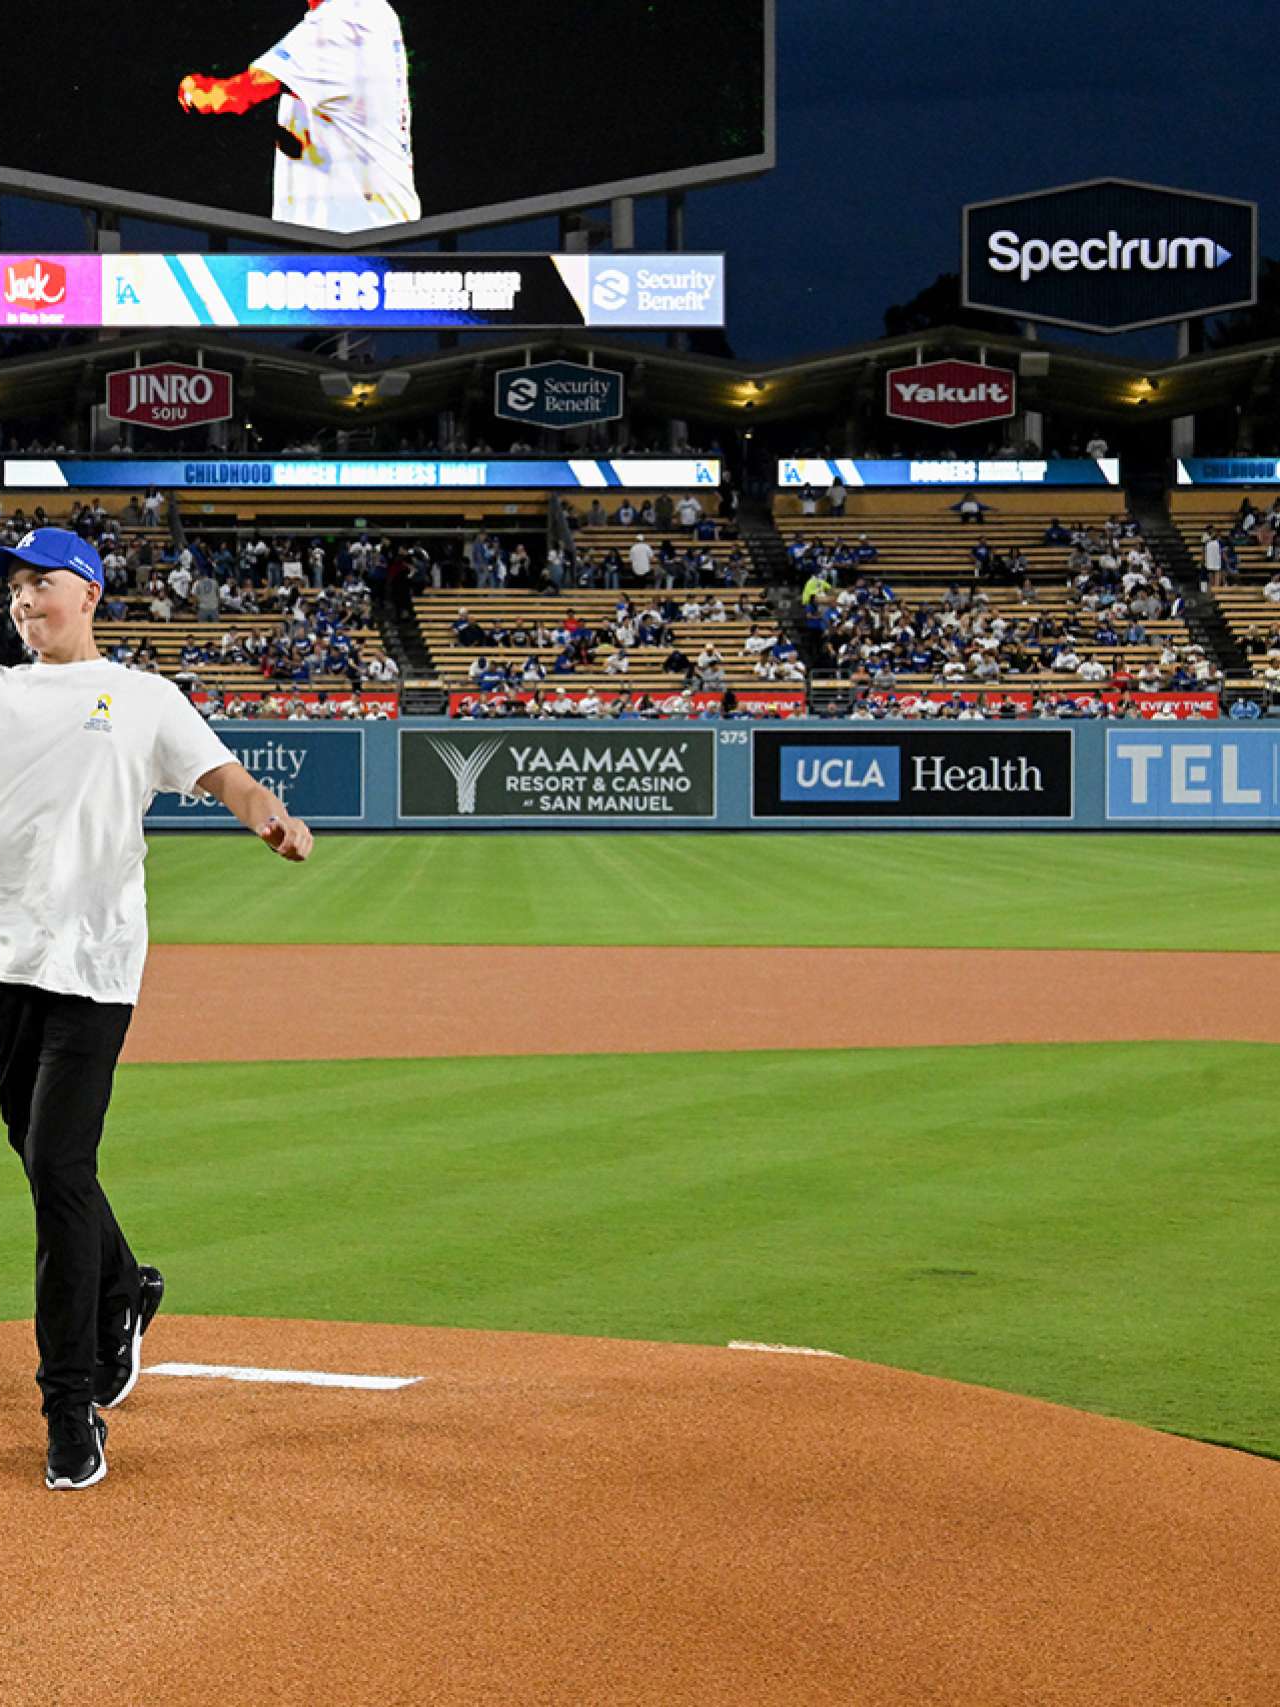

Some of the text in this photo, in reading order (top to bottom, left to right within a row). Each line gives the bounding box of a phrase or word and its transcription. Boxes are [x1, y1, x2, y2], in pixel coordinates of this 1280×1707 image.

[987, 230, 1215, 282] Spectrum
[4, 263, 65, 302] Jack
[115, 275, 141, 305] LA
[636, 269, 716, 292] Security
[637, 291, 705, 312] Benefit
[126, 374, 213, 413] JINRO
[544, 378, 610, 397] Security
[894, 383, 1009, 403] Yakult
[151, 407, 187, 420] SOJU
[544, 396, 601, 412] Benefit
[185, 463, 271, 485] CHILDHOOD
[719, 731, 747, 744] 375
[506, 776, 692, 792] RESORT & CASINO
[796, 755, 1044, 792] UCLA Health
[1116, 744, 1262, 804] TEL
[539, 795, 581, 811] SAN
[587, 795, 675, 812] MANUEL
